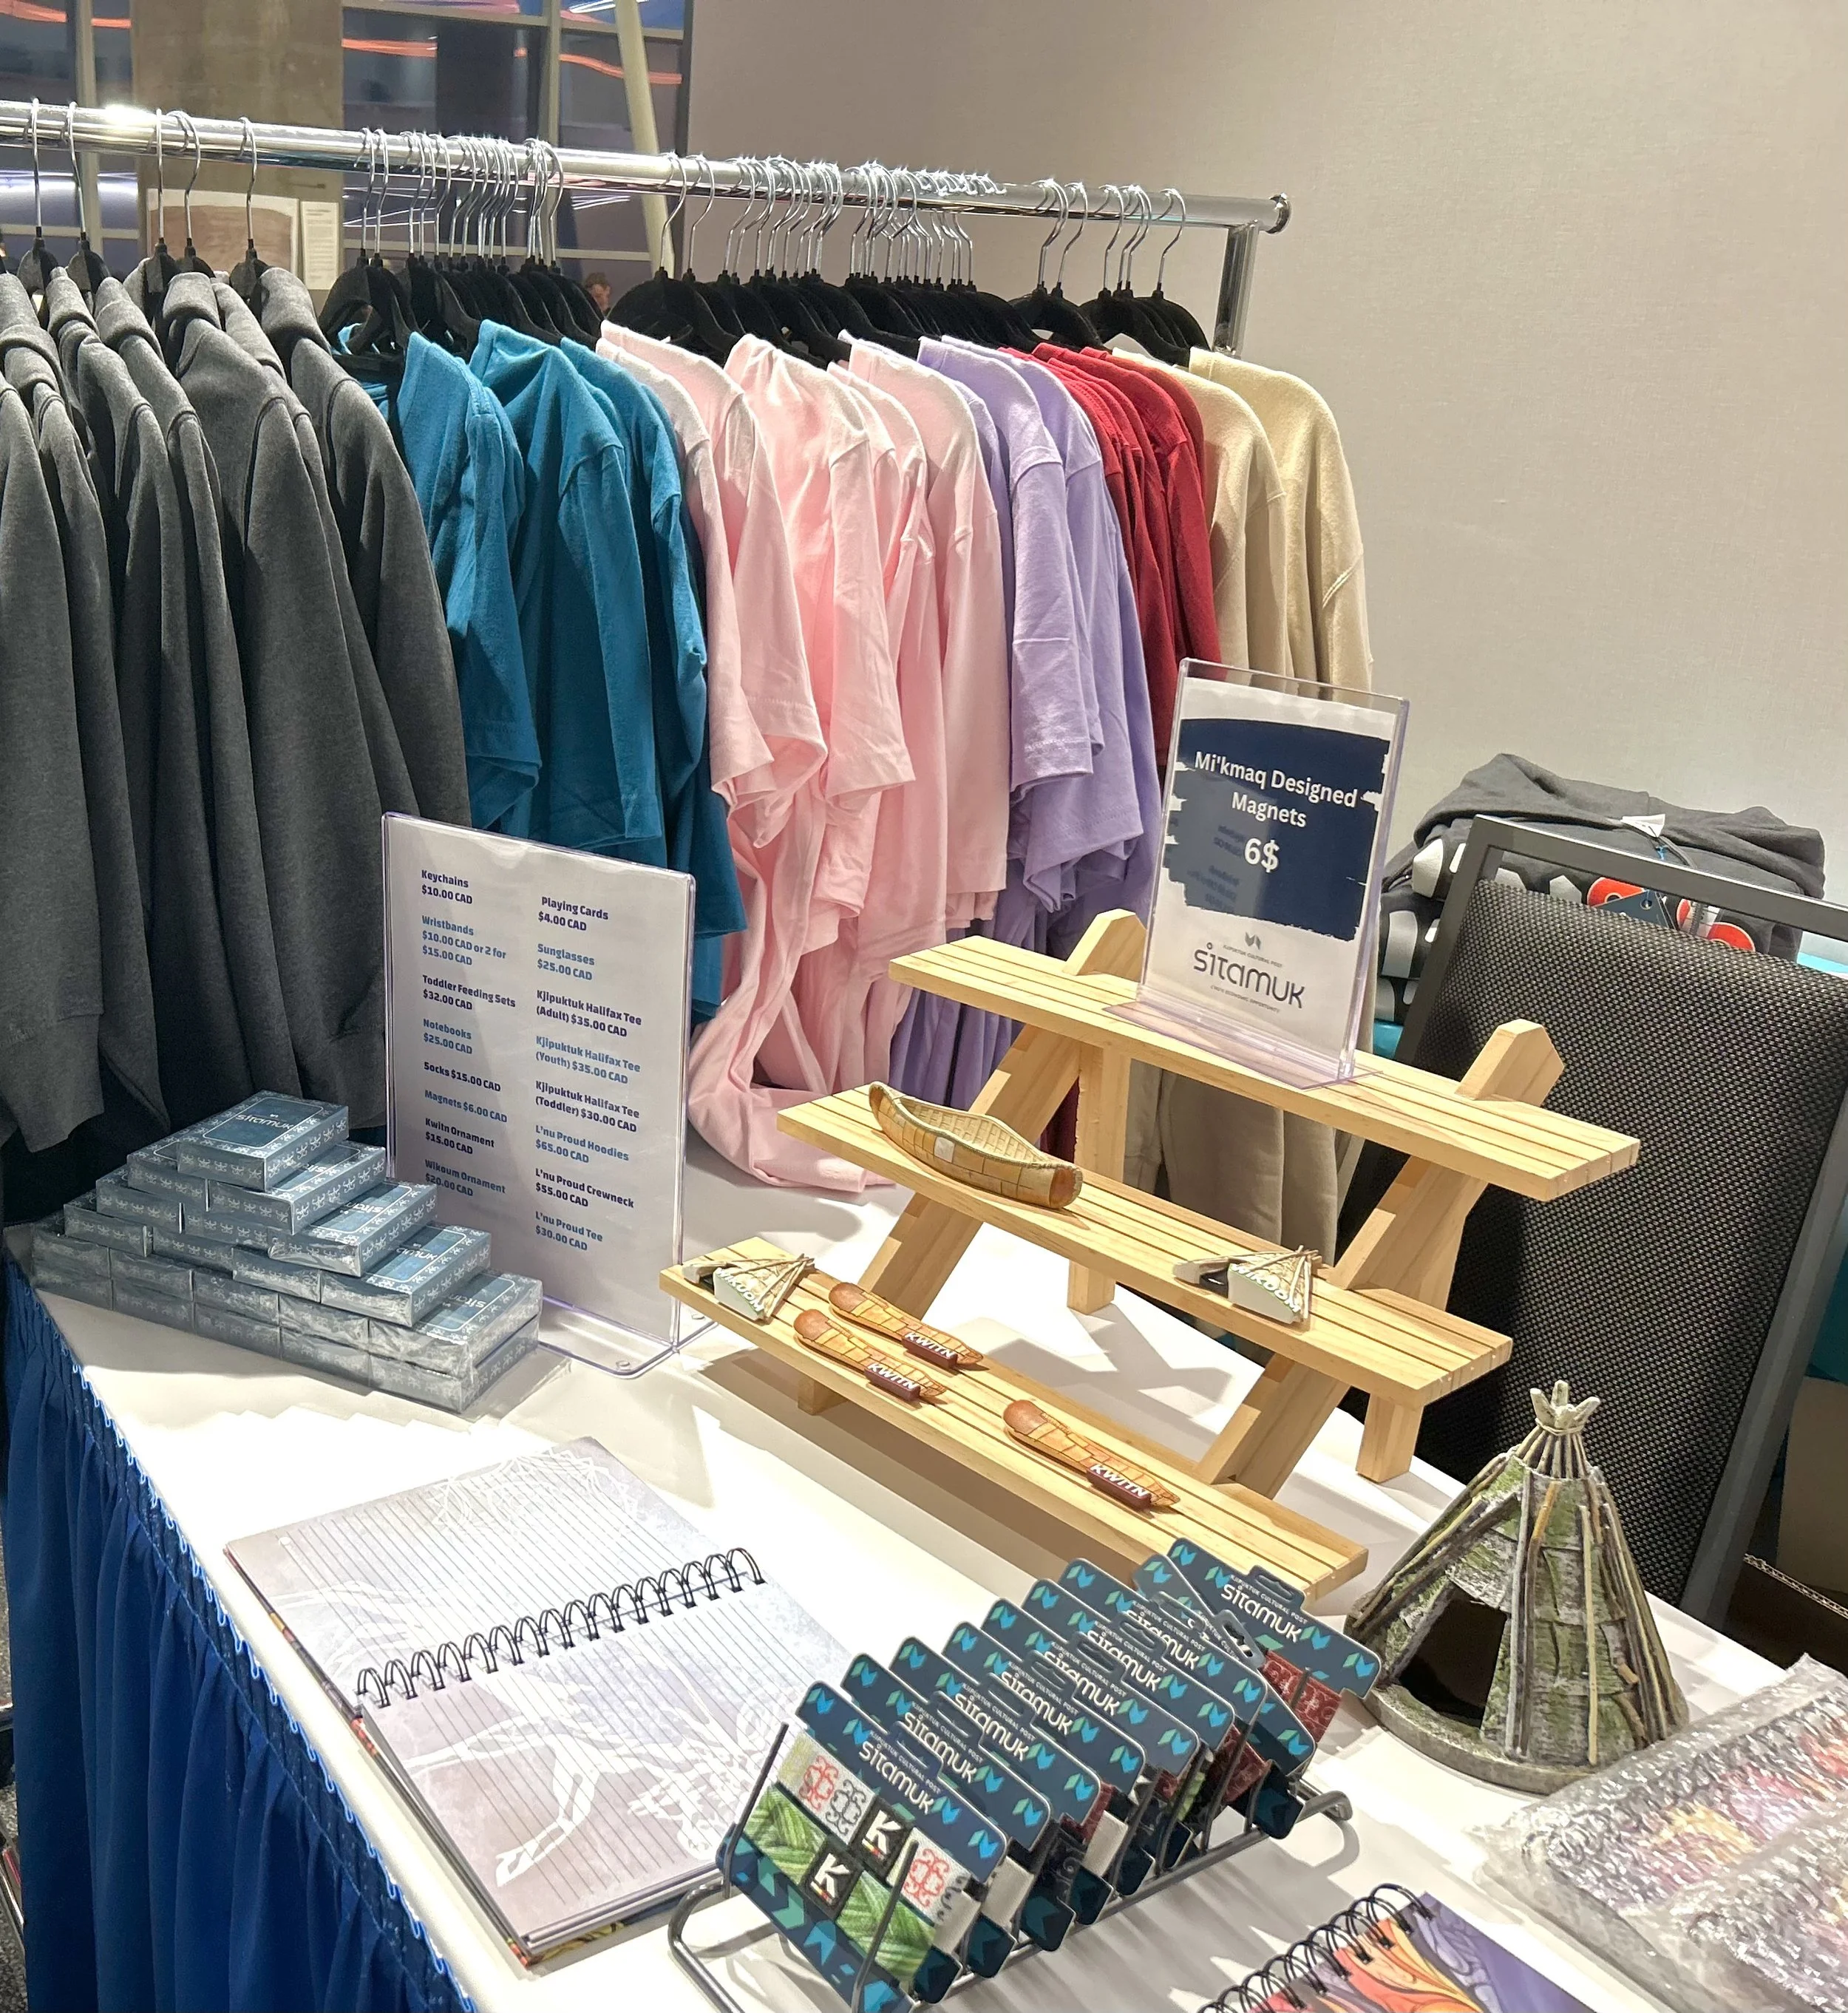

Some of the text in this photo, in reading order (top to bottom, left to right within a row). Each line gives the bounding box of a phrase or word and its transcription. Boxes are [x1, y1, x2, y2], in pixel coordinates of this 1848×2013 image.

[1194, 750, 1359, 808] Mi'kmaq Designed
[1232, 791, 1308, 829] Magnets
[1244, 838, 1280, 873] 6$
[421, 869, 469, 888] Keychains
[421, 884, 472, 904] $10.00 CAD
[538, 911, 587, 931] $4.00 CAD
[542, 896, 609, 920] Playing Cards
[422, 915, 474, 936] Wristbands
[422, 931, 506, 960] $10.00 CAD or 2 for
[422, 945, 472, 965] $15.00 CAD
[537, 943, 595, 965] Sunglasses
[537, 958, 592, 981] $25.00 CAD
[422, 974, 516, 1008] Toddler Feeding Sets
[423, 989, 472, 1011] $32.00 CAD
[537, 990, 642, 1025] Kjipuktuk Halifax Tee
[537, 1005, 627, 1037] (Adult) $35.00 CAD
[424, 1019, 472, 1039] Notebooks
[424, 1033, 472, 1054] $25.00 CAD
[536, 1036, 641, 1073] Kjipuktuk Halifax Tee
[536, 1051, 628, 1084] (Youth) $35.00 CAD
[424, 1062, 501, 1092] Socks $15.00 CAD
[424, 1090, 507, 1123] Magnets $6.00 CAD
[536, 1081, 640, 1118] Kjipuktuk Halifax Tee
[536, 1096, 636, 1133] (Toddler) $30.00 CAD
[425, 1118, 495, 1148] Kwitn Ornament
[425, 1132, 473, 1155] $15.00 CAD
[536, 1124, 629, 1161] L'nu Proud Hoodies
[536, 1139, 589, 1164] $65.00 CAD
[425, 1159, 506, 1194] Wikoum Ornament
[425, 1173, 473, 1197] $20.00 CAD
[536, 1168, 634, 1209] L'nu Proud Crewneck
[536, 1182, 589, 1207] $55.00 CAD
[536, 1211, 603, 1242] L'nu Proud Tee
[536, 1225, 588, 1251] $30.00 CAD
[905, 1331, 956, 1357] KWITN
[868, 1362, 918, 1389] KWITN
[1090, 1464, 1149, 1497] KWITN
[1261, 1594, 1290, 1614] CULTURAL
[1291, 1612, 1308, 1623] POST
[1163, 1620, 1189, 1642] CULTURAL
[1190, 1640, 1206, 1652] POST
[1124, 1641, 1150, 1662] CULTURAL
[1152, 1660, 1167, 1673] POST
[1081, 1662, 1109, 1686] CULTURAL
[1110, 1683, 1127, 1697] POST
[1036, 1681, 1062, 1705] CULTURAL
[1063, 1701, 1079, 1716] POST
[992, 1705, 1019, 1731] CULTURAL
[1019, 1727, 1036, 1742] POST
[940, 1725, 967, 1751] CULTURAL
[968, 1748, 984, 1764] POST
[898, 1755, 925, 1782] CULTURAL
[925, 1779, 942, 1795] POST
[866, 1810, 904, 1853] K
[813, 1853, 851, 1895] K
